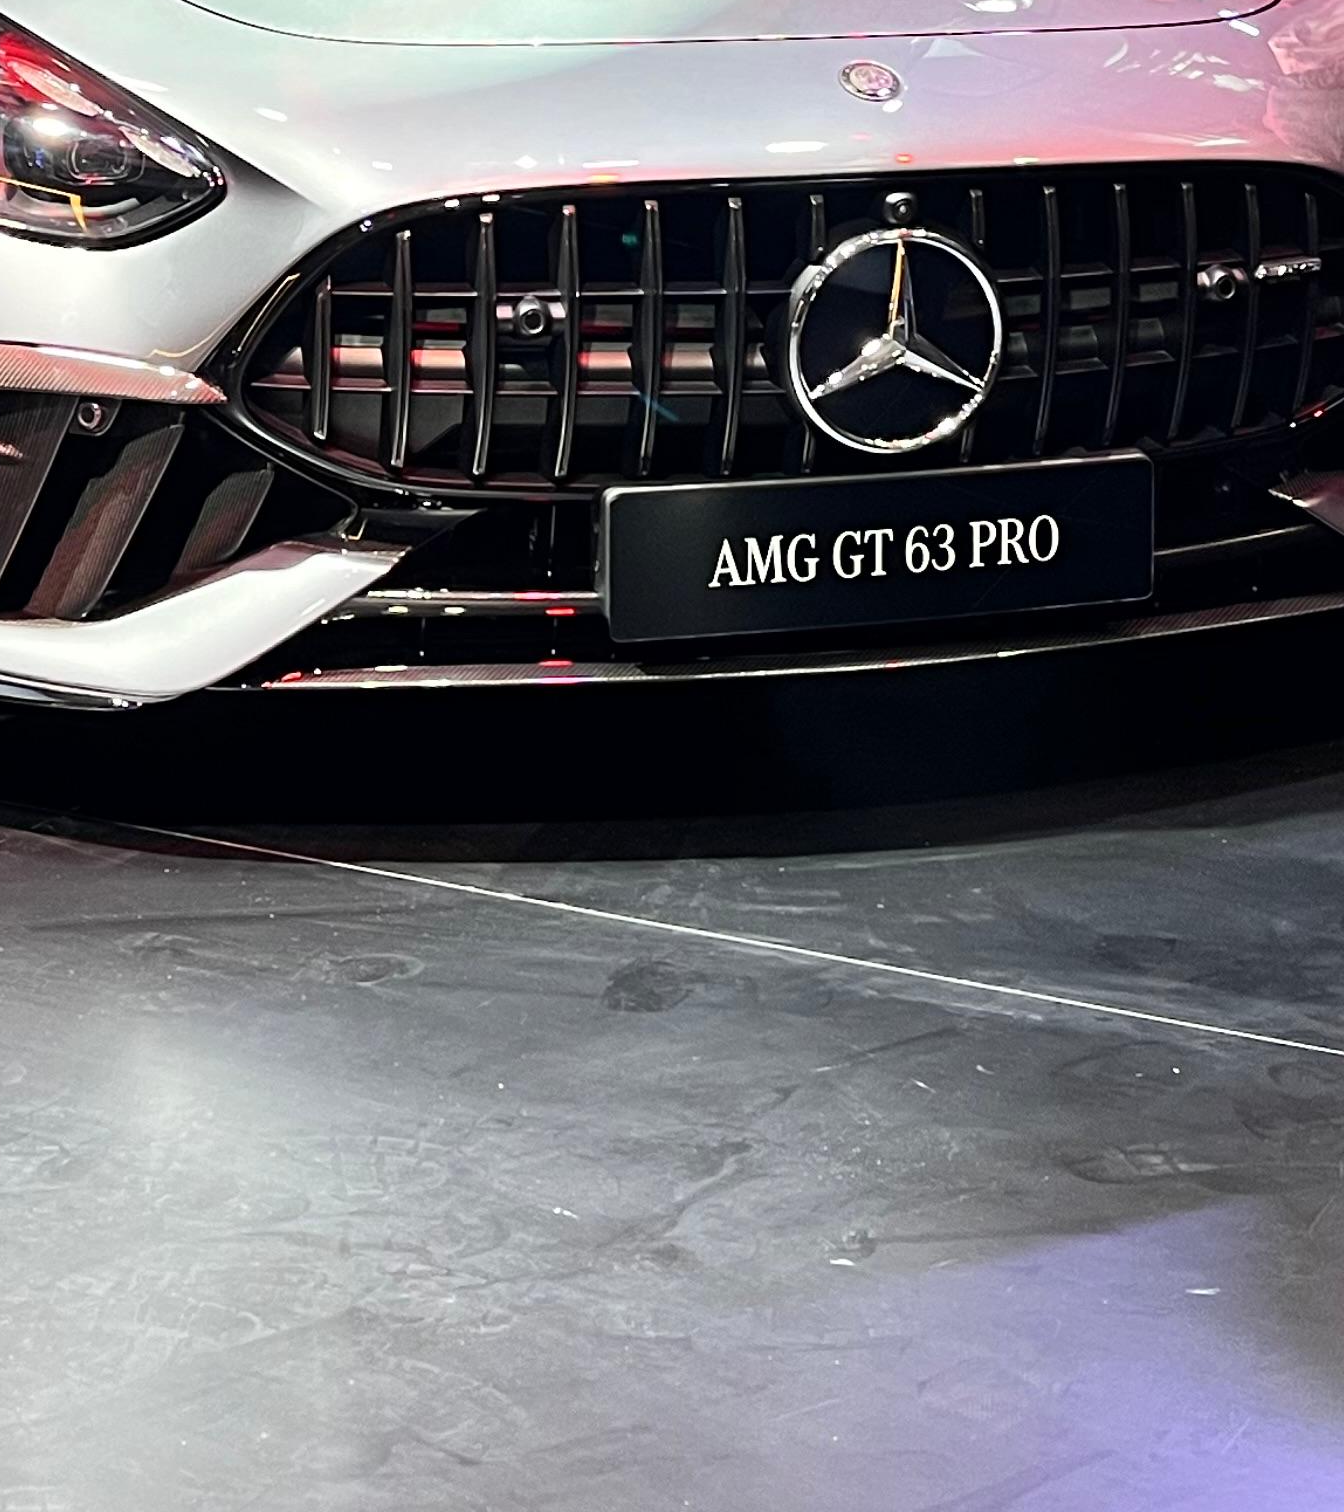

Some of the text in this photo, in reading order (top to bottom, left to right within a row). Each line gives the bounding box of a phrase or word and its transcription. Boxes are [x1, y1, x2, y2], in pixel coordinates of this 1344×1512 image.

[707, 514, 1059, 588] AMG GT 63 PRO
